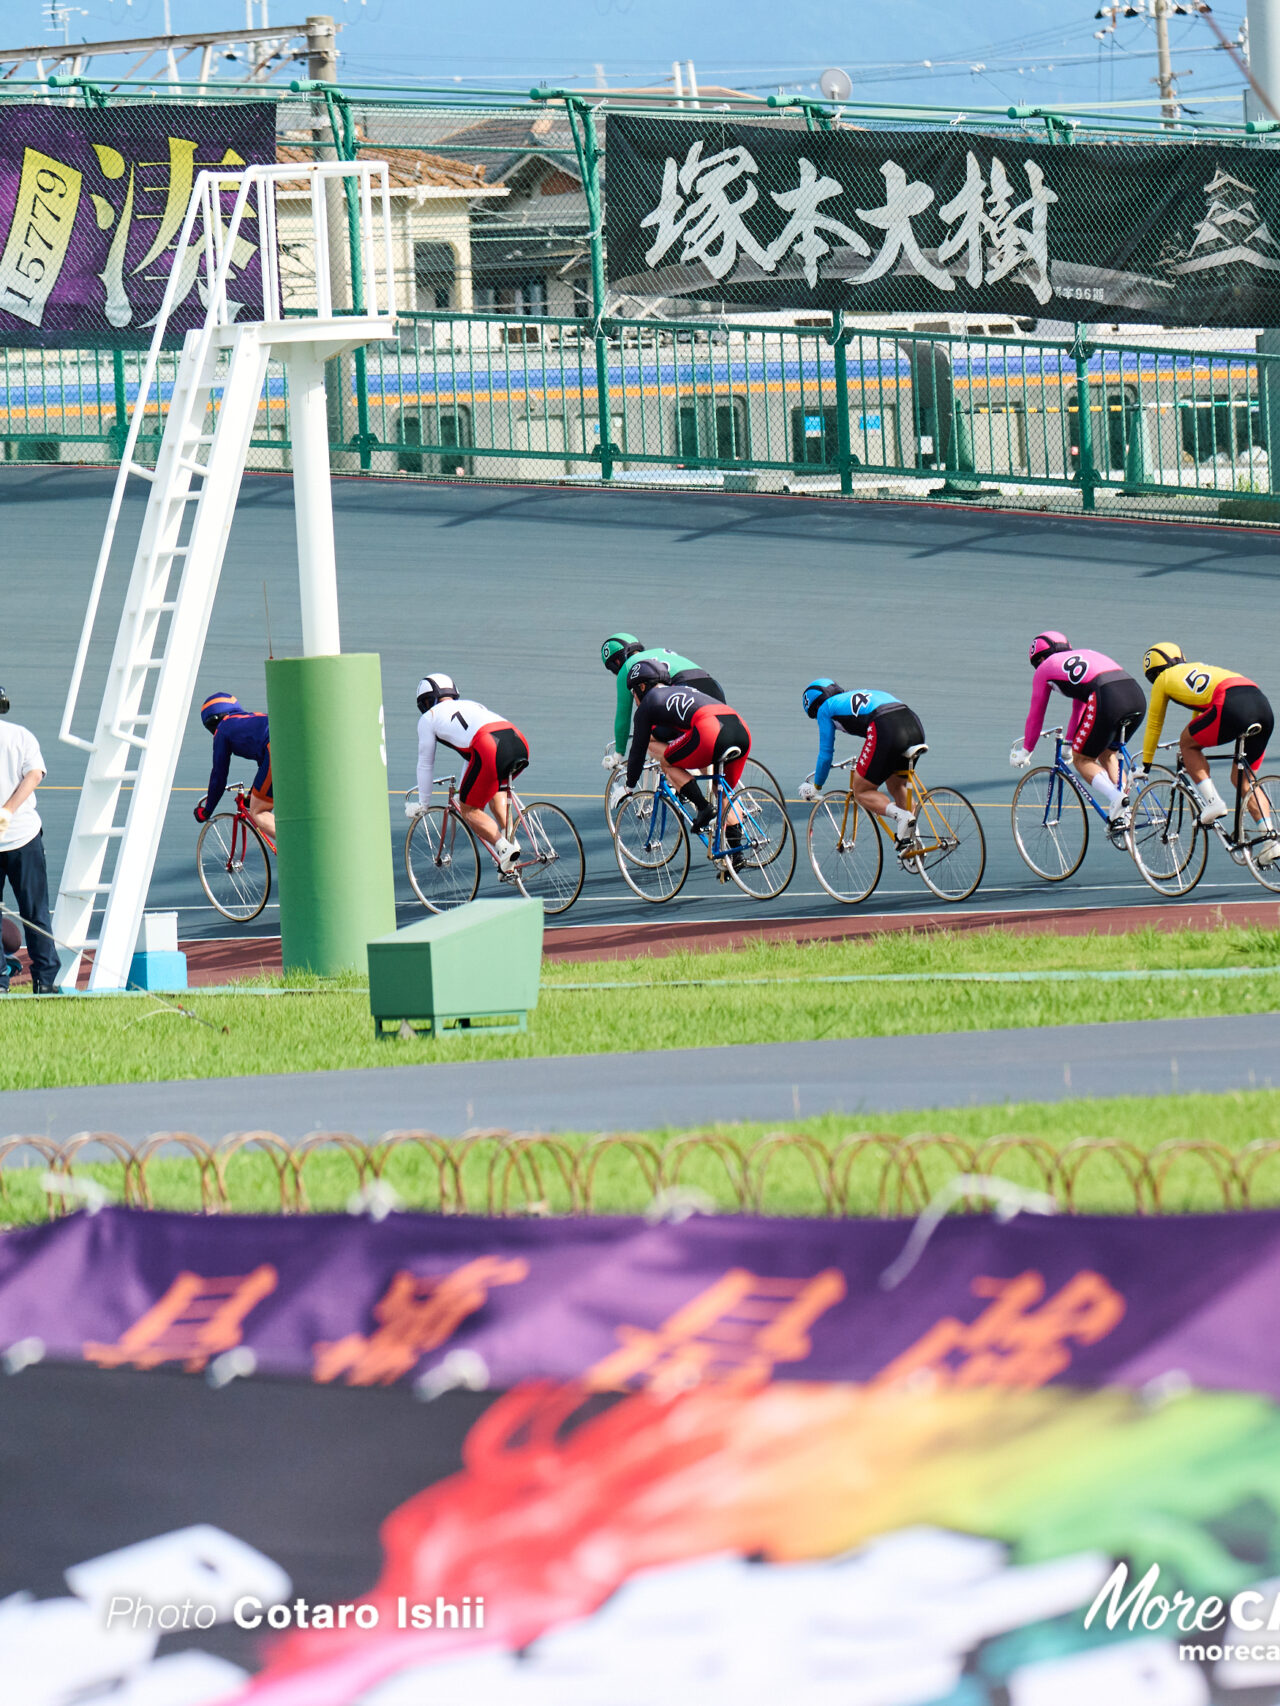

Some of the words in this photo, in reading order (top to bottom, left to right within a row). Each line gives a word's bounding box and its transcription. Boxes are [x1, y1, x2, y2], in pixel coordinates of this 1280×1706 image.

[640, 140, 1058, 305] 塚本大樹
[4, 168, 68, 308] 15779
[630, 663, 641, 679] 2
[1062, 655, 1089, 684] 8
[1184, 669, 1211, 694] 5
[666, 692, 695, 720] 2
[850, 692, 873, 717] 4
[450, 711, 469, 731] 1
